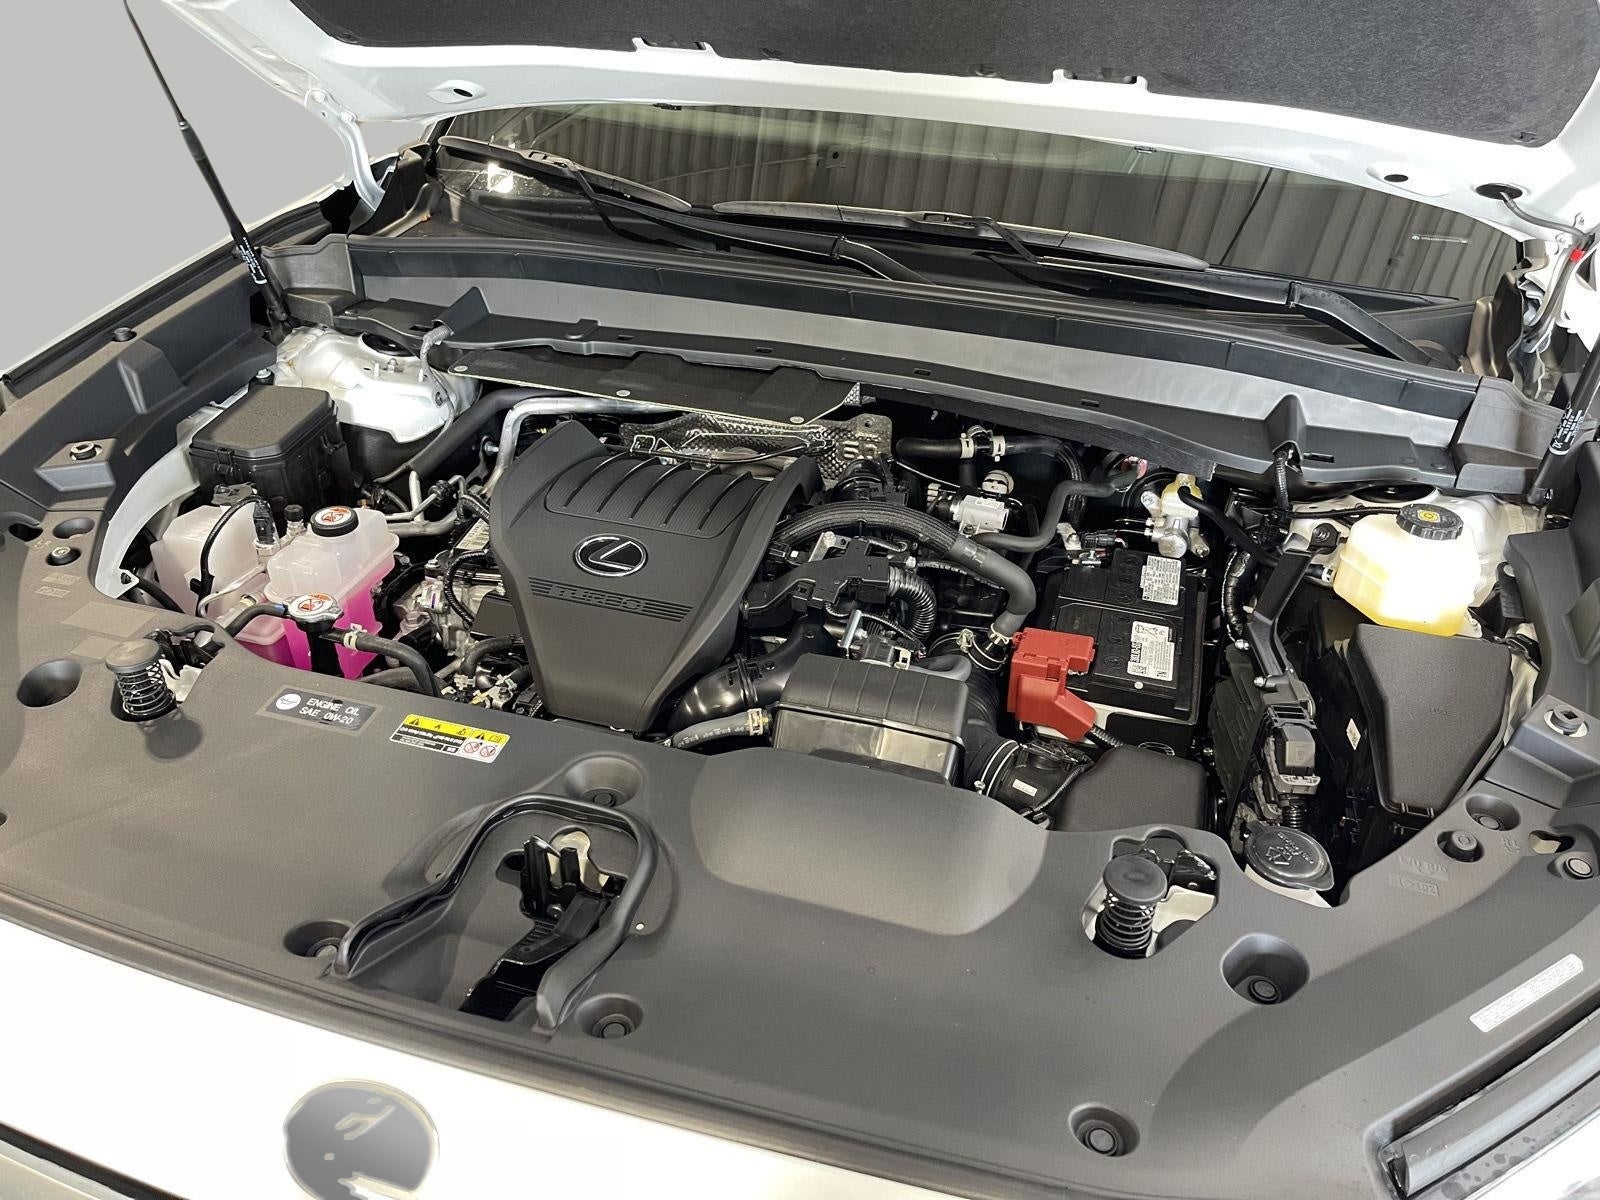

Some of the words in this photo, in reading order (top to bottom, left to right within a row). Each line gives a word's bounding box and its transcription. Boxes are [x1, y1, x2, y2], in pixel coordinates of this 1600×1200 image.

[551, 585, 642, 611] TURBO
[299, 706, 321, 717] SAE
[323, 711, 354, 725] 0W-20
[306, 697, 343, 712] ENGINE
[344, 706, 360, 716] OIL
